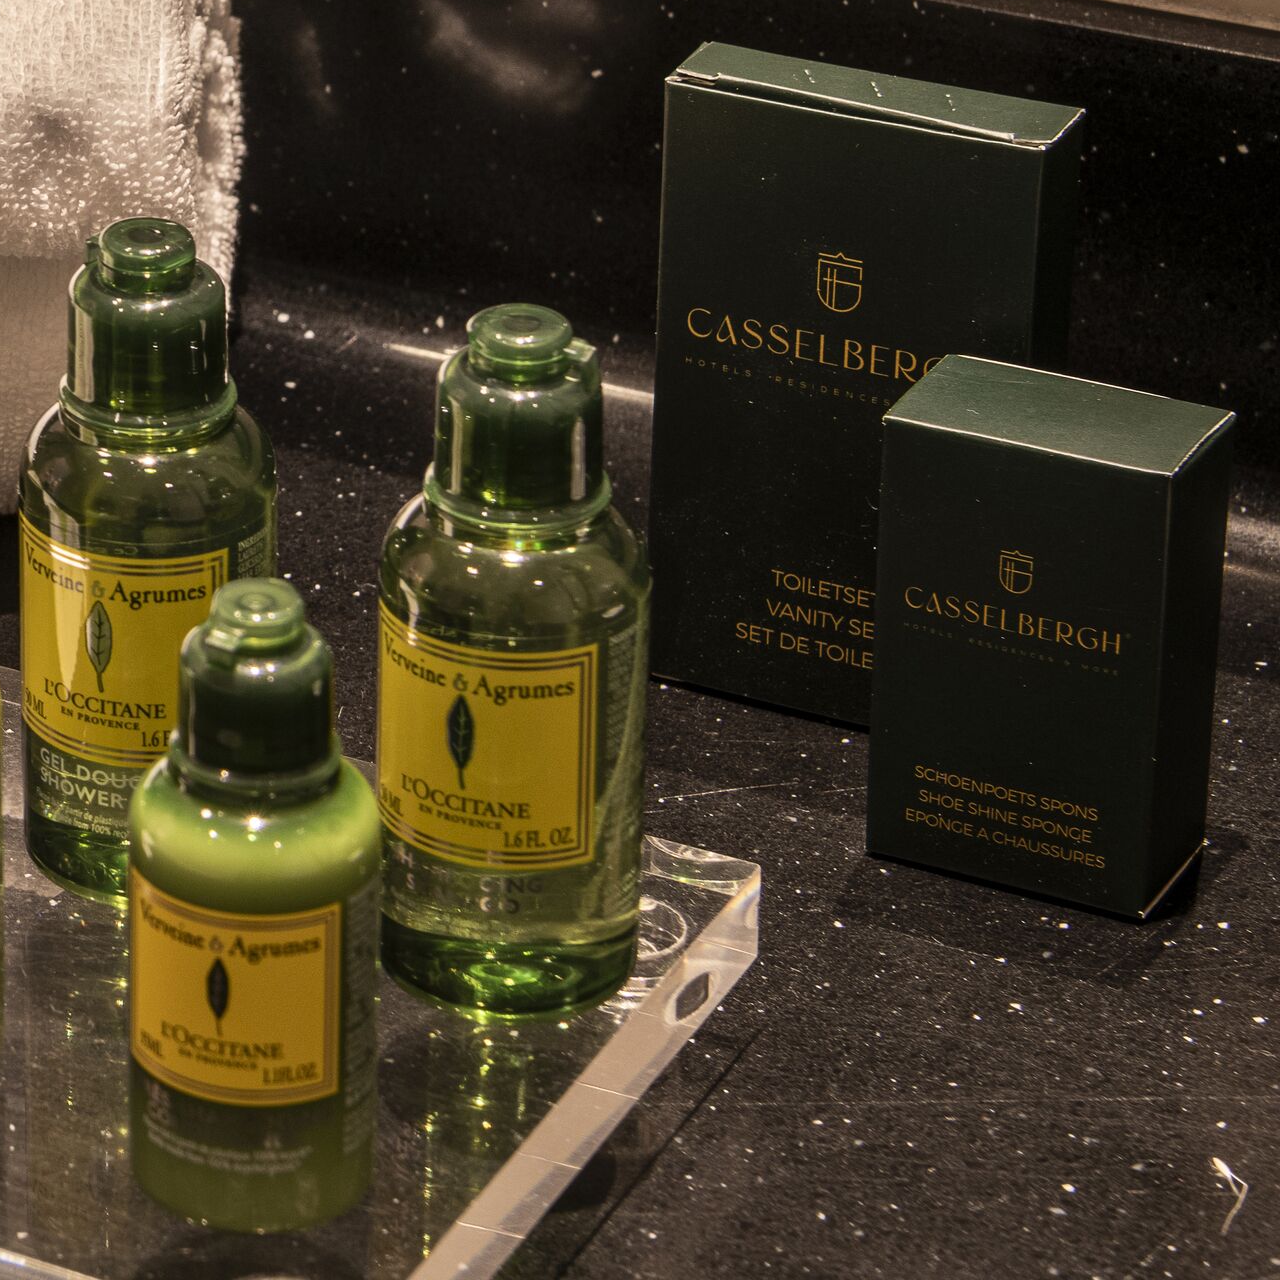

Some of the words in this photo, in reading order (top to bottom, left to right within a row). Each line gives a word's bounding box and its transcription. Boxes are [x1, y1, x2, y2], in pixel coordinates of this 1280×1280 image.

[687, 307, 942, 383] CASSELBER
[685, 357, 753, 379] HOTELS
[774, 375, 891, 407] RESIDENCES
[25, 541, 85, 594] Verveine
[92, 582, 107, 599] &
[109, 581, 207, 610] Agrumes
[765, 598, 844, 631] VANITY
[848, 618, 875, 640] SE
[904, 586, 1123, 656] CASSELBERGH
[383, 631, 446, 688] Verveine
[452, 672, 469, 693] &
[473, 674, 575, 707] Agrumes
[735, 621, 775, 646] SET
[779, 632, 810, 655] DE
[813, 640, 874, 670] TOILE
[43, 676, 167, 720] L'OCCITANE
[60, 707, 76, 717] EN
[77, 712, 141, 731] PROVENCE
[141, 730, 160, 748] 1.6
[39, 747, 67, 777] GEL
[76, 762, 140, 789] DOUC
[401, 773, 531, 820] L'OCCITANE
[914, 765, 1037, 808] SCHOENPOETS
[1040, 797, 1099, 821] SPONS
[918, 789, 964, 812] SHOE
[968, 803, 1019, 826] SHINE
[1021, 815, 1093, 844] SPONGE
[435, 808, 503, 831] PROVENCE
[905, 808, 974, 837] EPONGE
[976, 827, 989, 841] A
[992, 831, 1106, 869] CHAUSSURES
